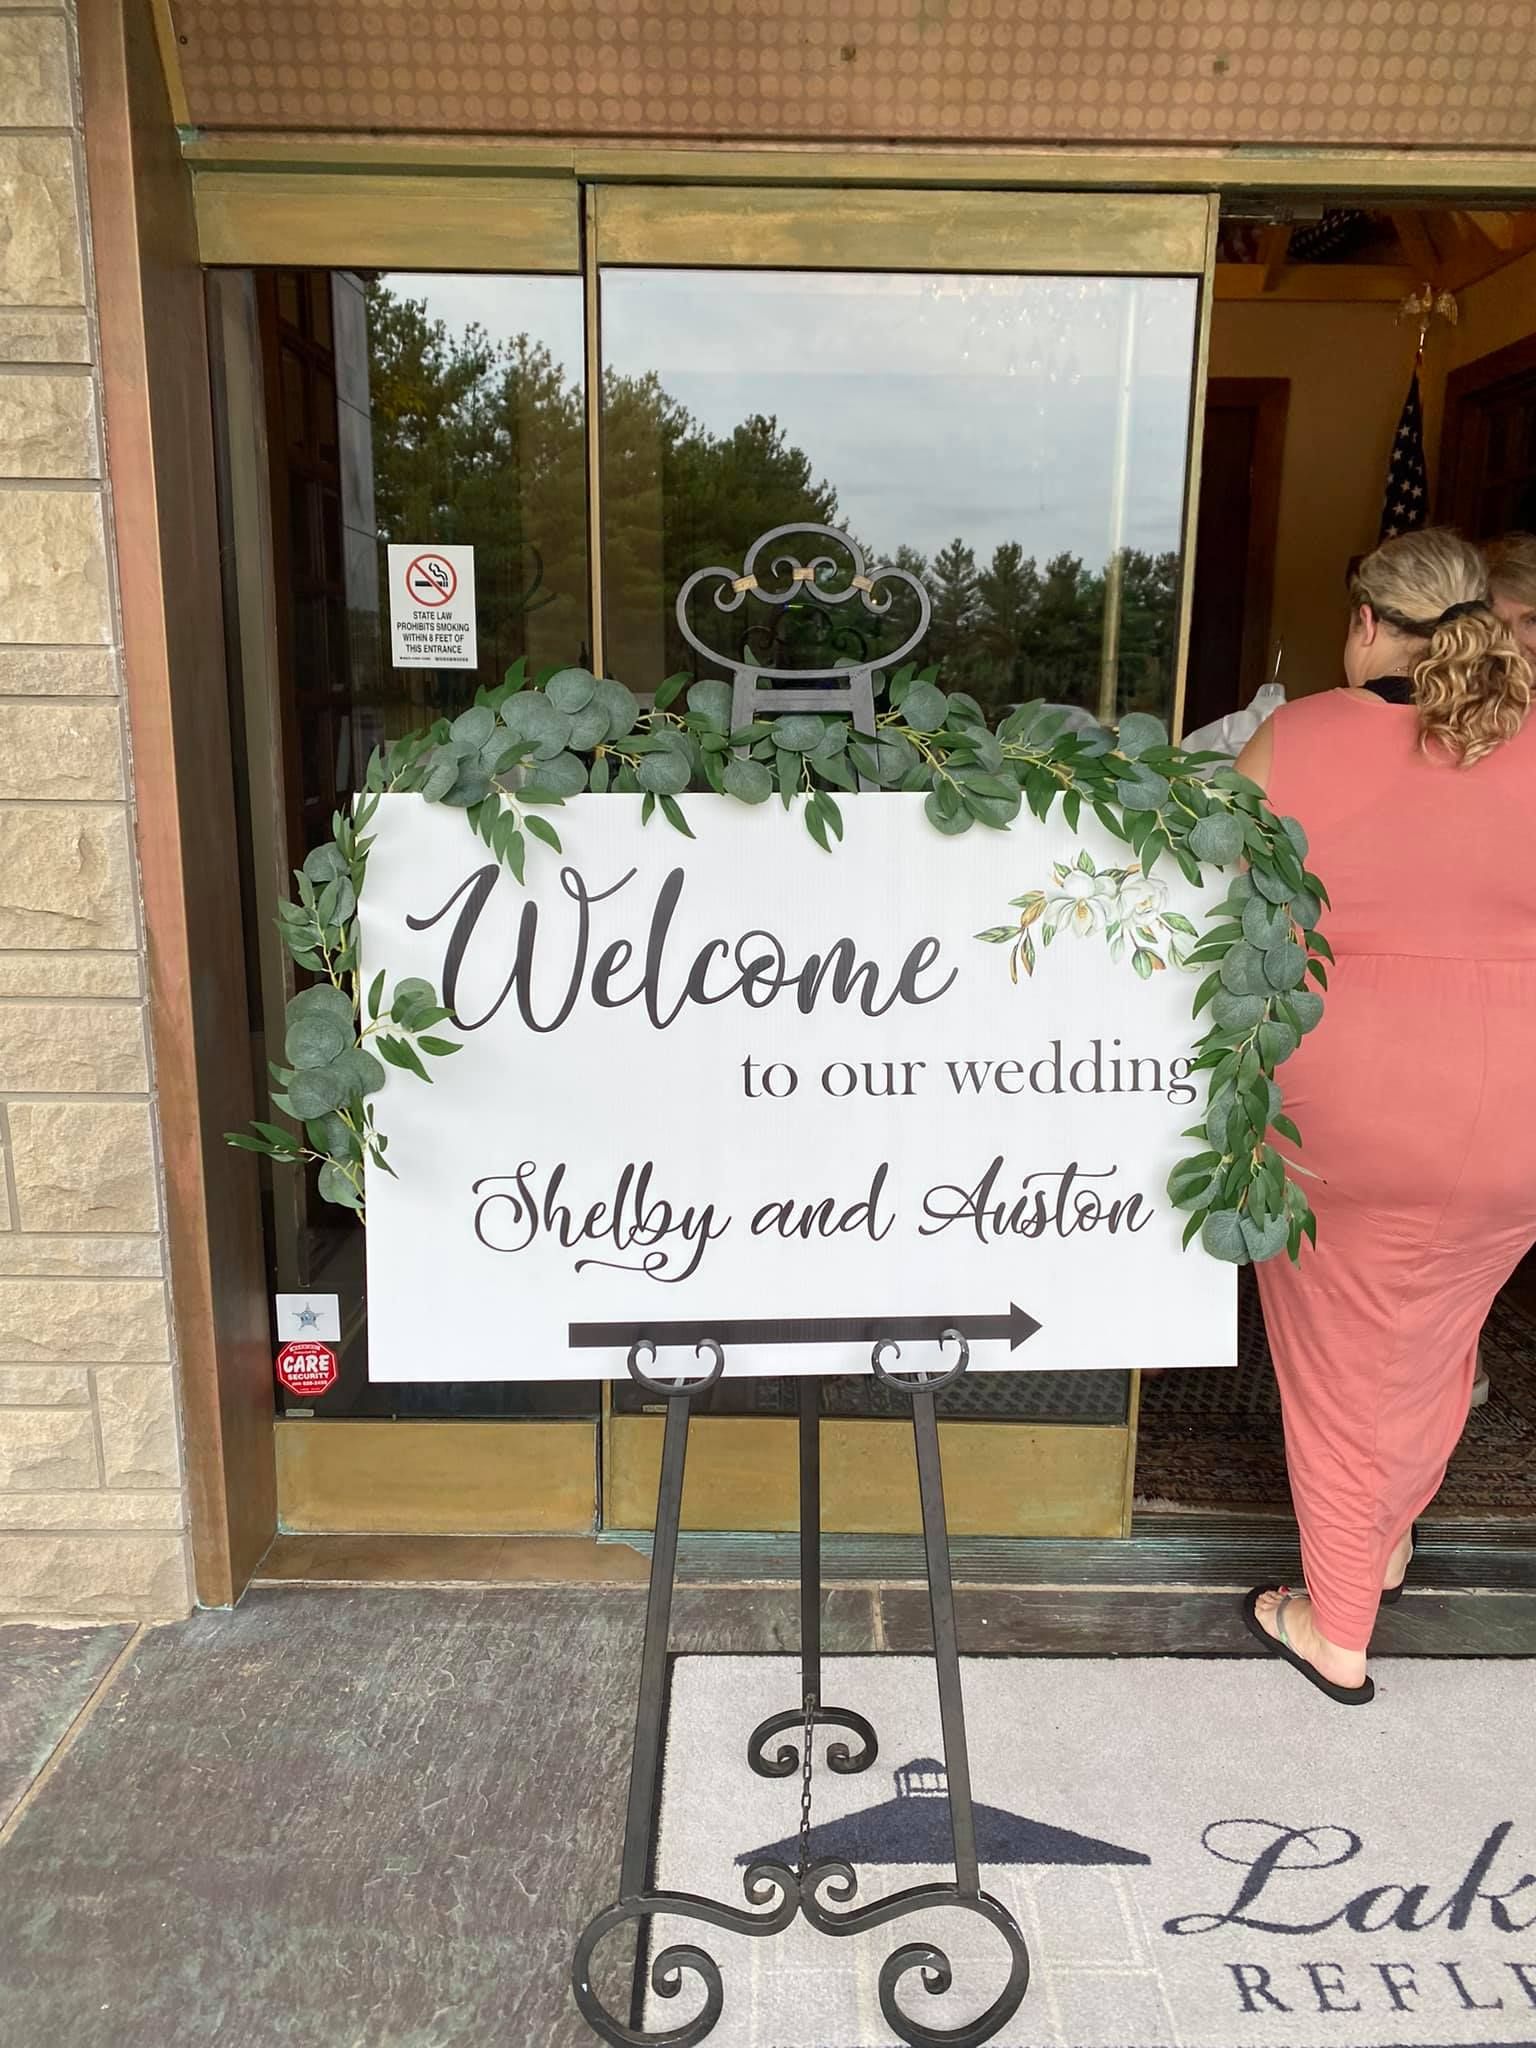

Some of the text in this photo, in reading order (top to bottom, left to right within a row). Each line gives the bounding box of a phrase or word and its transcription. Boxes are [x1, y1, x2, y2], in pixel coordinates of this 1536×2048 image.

[413, 611, 452, 620] STATE LAW
[397, 622, 470, 632] PROHIBITS SMOKING
[403, 633, 465, 642] WITHIN 8 FEET OF
[406, 645, 463, 654] THIS ENTRANCE
[406, 863, 959, 1033] Welcome
[741, 1040, 1198, 1105] to our wedding
[472, 1155, 1154, 1283] Shelby and Auston
[283, 1355, 329, 1373] CARE
